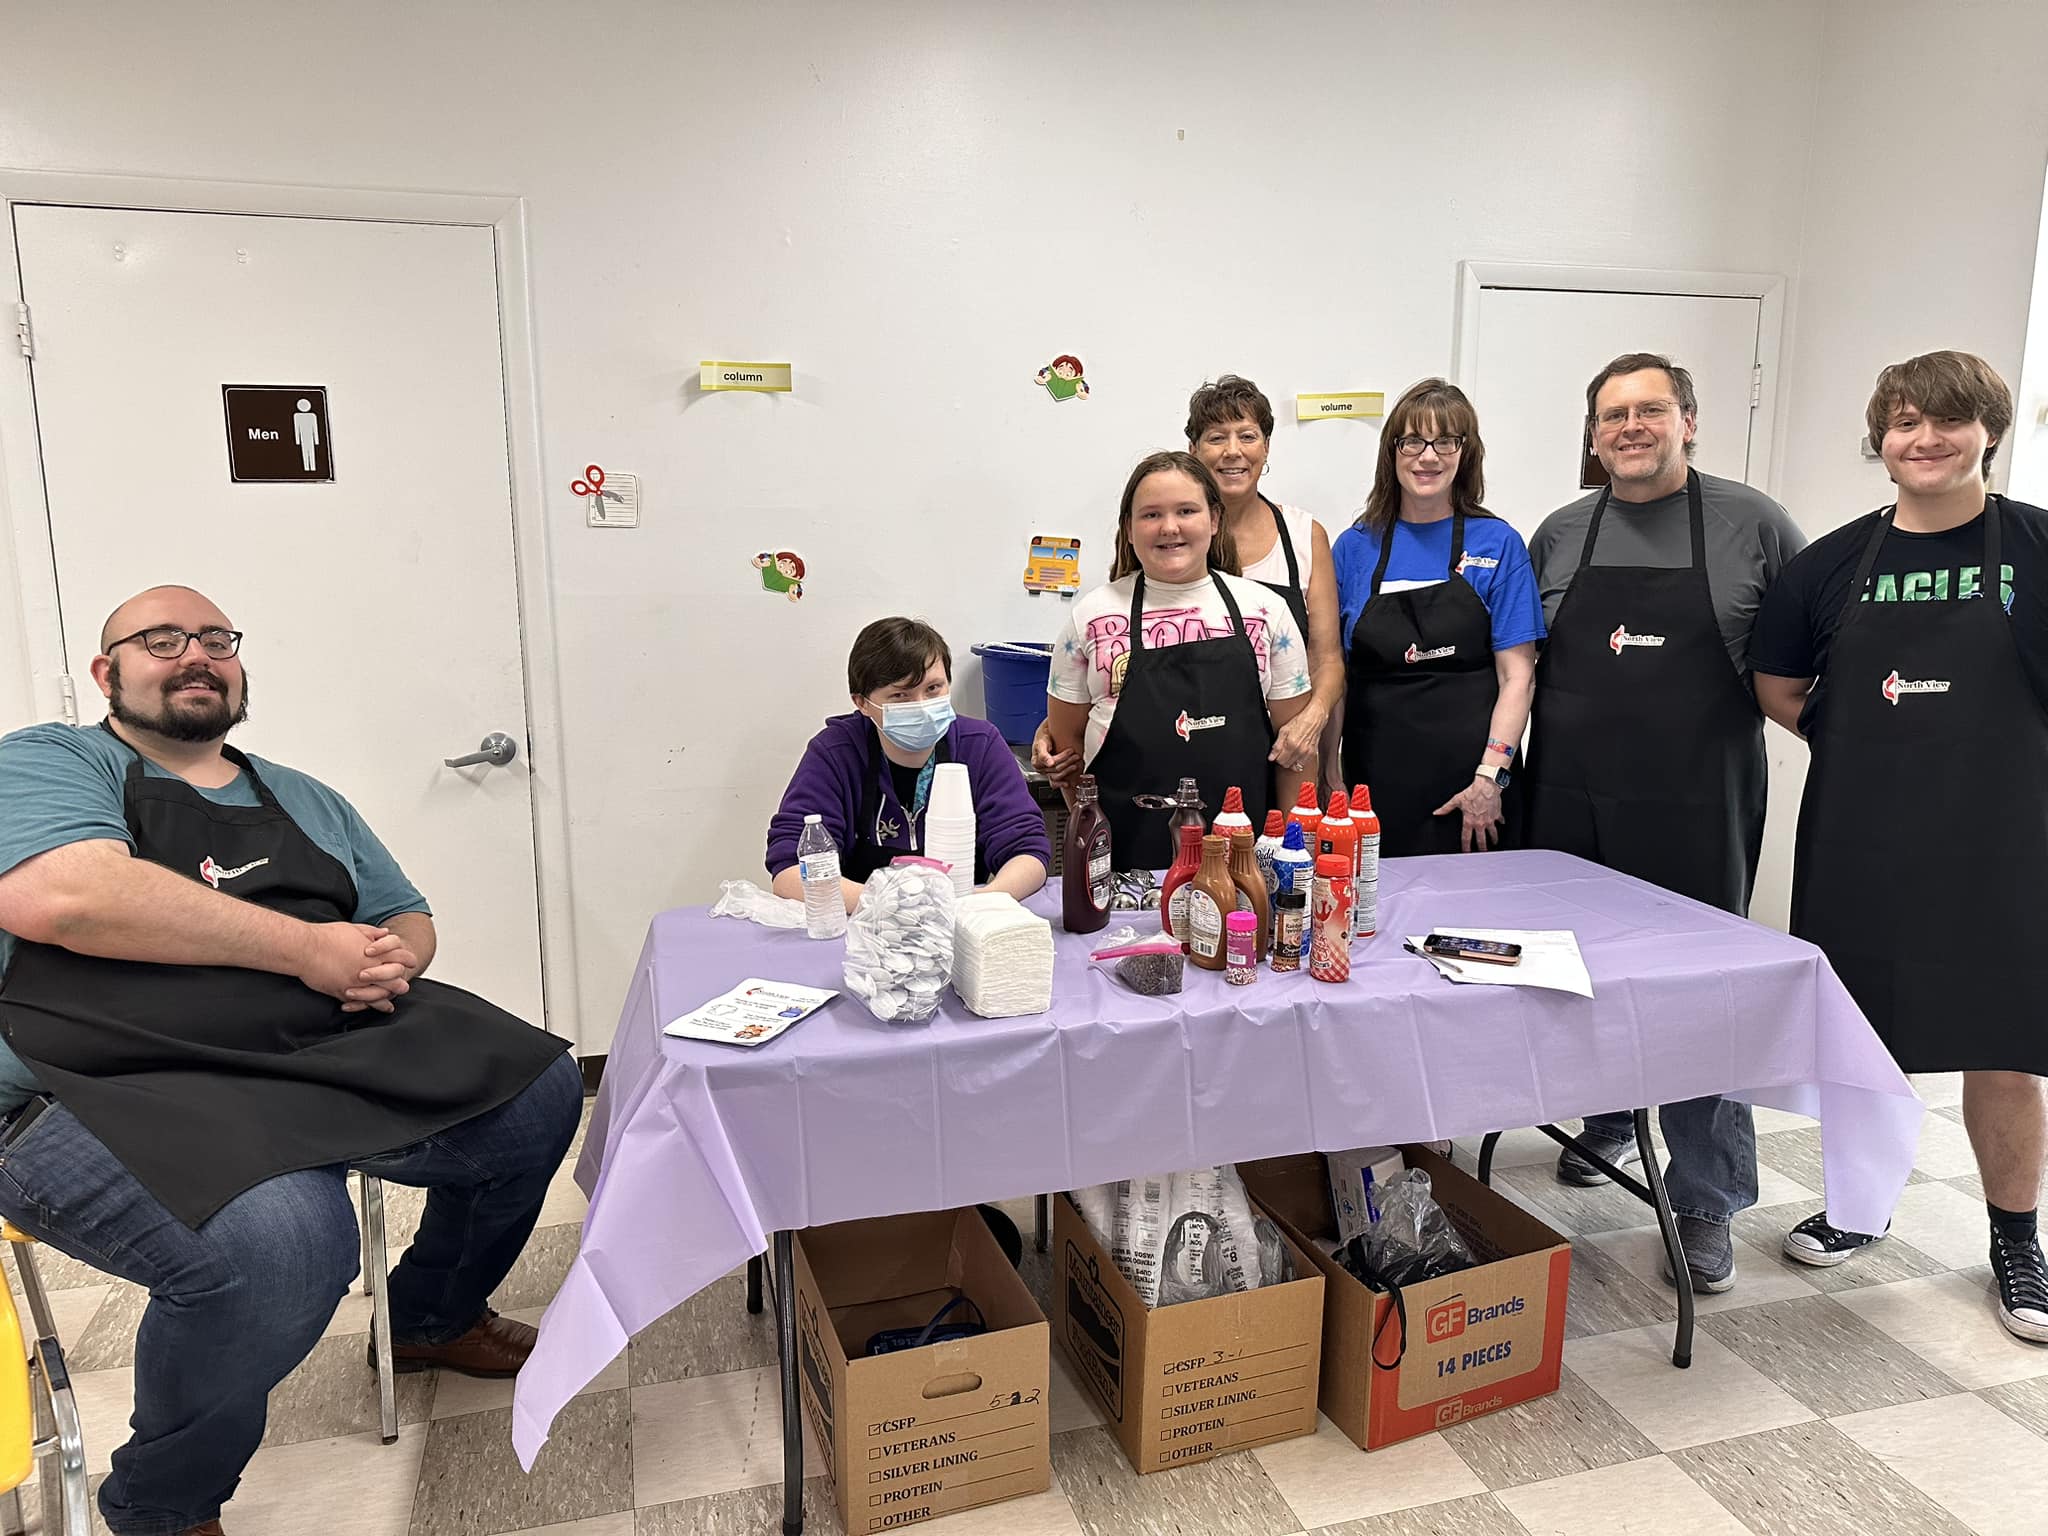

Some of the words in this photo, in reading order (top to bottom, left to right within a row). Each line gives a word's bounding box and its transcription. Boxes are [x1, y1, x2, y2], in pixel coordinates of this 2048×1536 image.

[723, 371, 763, 382] column
[1320, 403, 1353, 411] volume
[248, 428, 280, 440] Men
[1898, 681, 1924, 689] North
[1431, 1307, 1463, 1337] GF
[1467, 1296, 1525, 1326] Brands
[1176, 1357, 1206, 1373] CSFP
[1437, 1357, 1457, 1378] 14
[1462, 1340, 1512, 1371] PIECES
[1175, 1372, 1239, 1394] VETERANS
[1173, 1398, 1215, 1417] SILVER
[1217, 1389, 1257, 1407] LINING
[1439, 1401, 1461, 1422] GF
[1463, 1395, 1503, 1416] Brands
[882, 1416, 916, 1433] CSFP
[1173, 1417, 1225, 1439] PROTEIN
[882, 1431, 957, 1457] VETERANS
[1172, 1441, 1213, 1460] OTHER
[882, 1461, 930, 1481] SILVER
[933, 1450, 979, 1470] LINING
[883, 1480, 943, 1504] PROTEIN
[883, 1506, 931, 1526] OTHER
